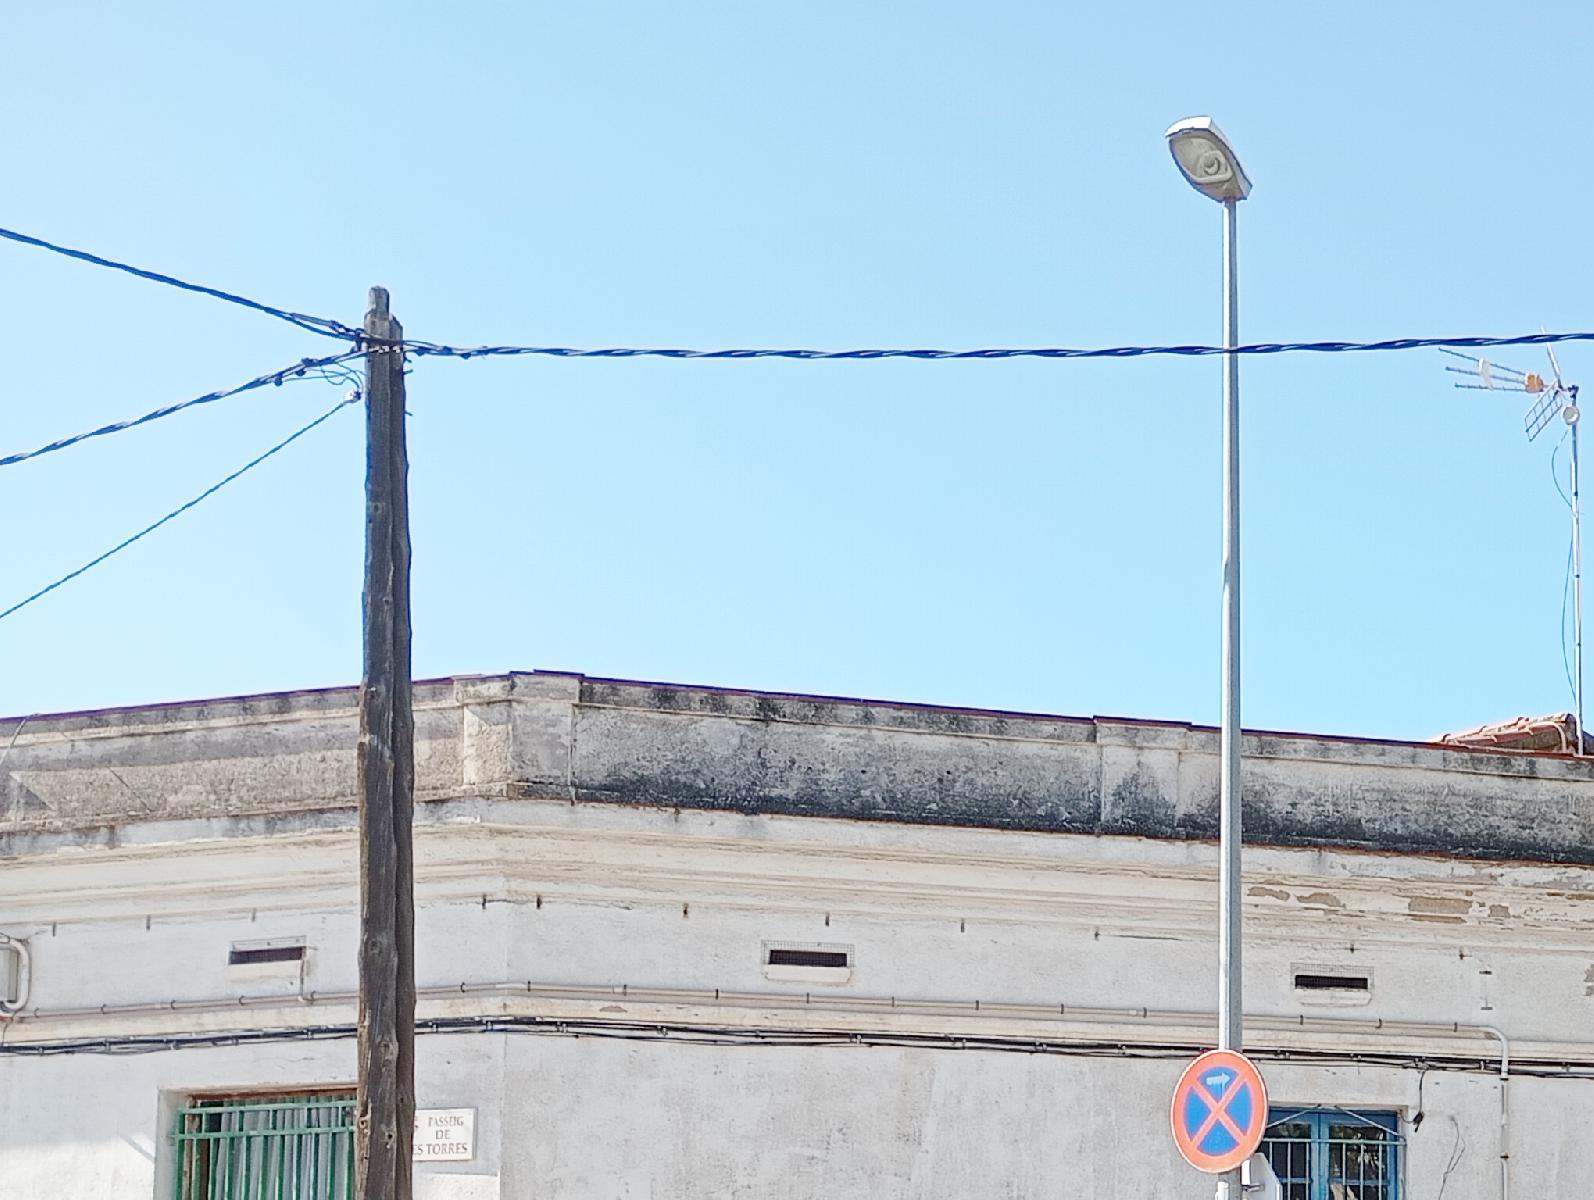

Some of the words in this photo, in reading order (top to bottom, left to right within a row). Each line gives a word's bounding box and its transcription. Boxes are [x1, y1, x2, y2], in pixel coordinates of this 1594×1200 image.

[428, 1116, 465, 1127] PASSEIG
[436, 1130, 451, 1140] DE
[426, 1142, 469, 1155] TORRES
